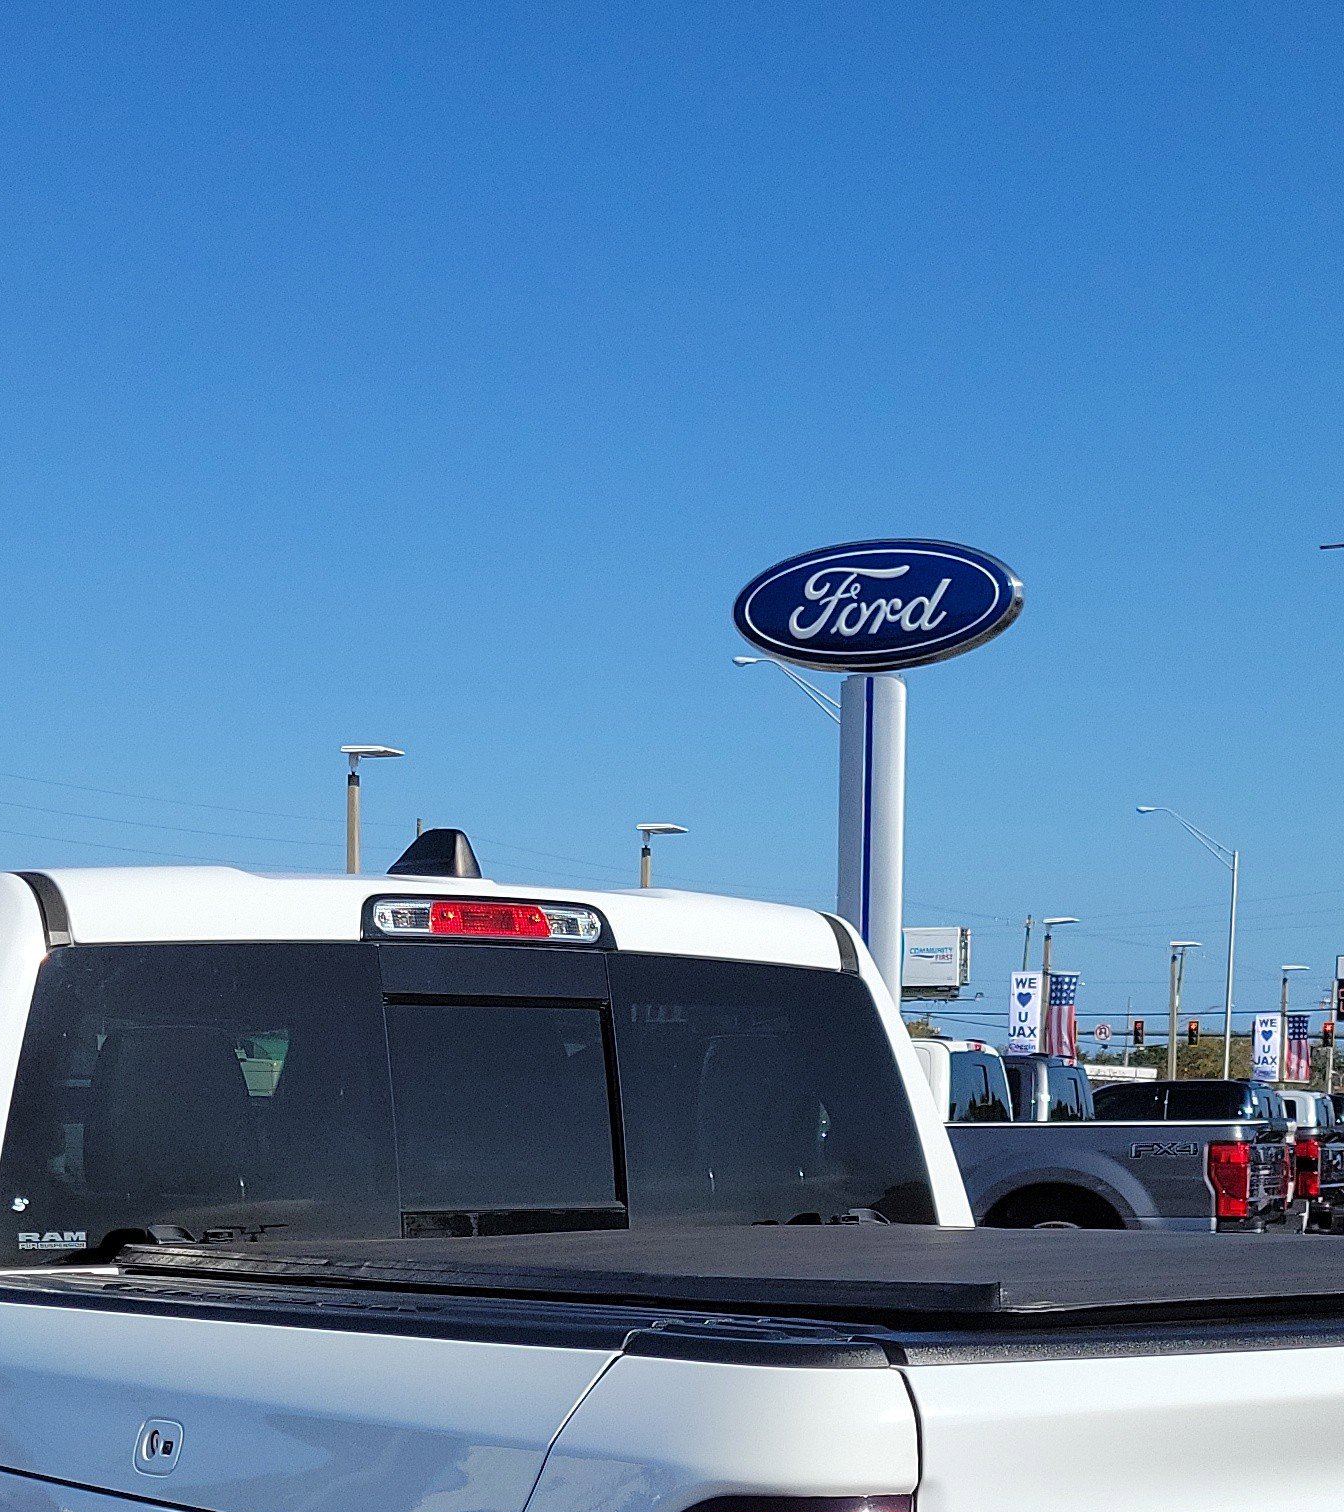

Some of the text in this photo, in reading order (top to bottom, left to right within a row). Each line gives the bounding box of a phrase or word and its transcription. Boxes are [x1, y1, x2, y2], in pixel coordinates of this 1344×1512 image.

[788, 564, 952, 640] Ford
[1015, 977, 1037, 989] WE
[1018, 1011, 1029, 1023] U
[1258, 1018, 1278, 1028] WE
[1008, 1025, 1037, 1038] JAX
[1262, 1044, 1271, 1054] U
[1254, 1055, 1278, 1066] JAX
[1129, 1142, 1199, 1160] FX4
[17, 1231, 87, 1242] RAM
